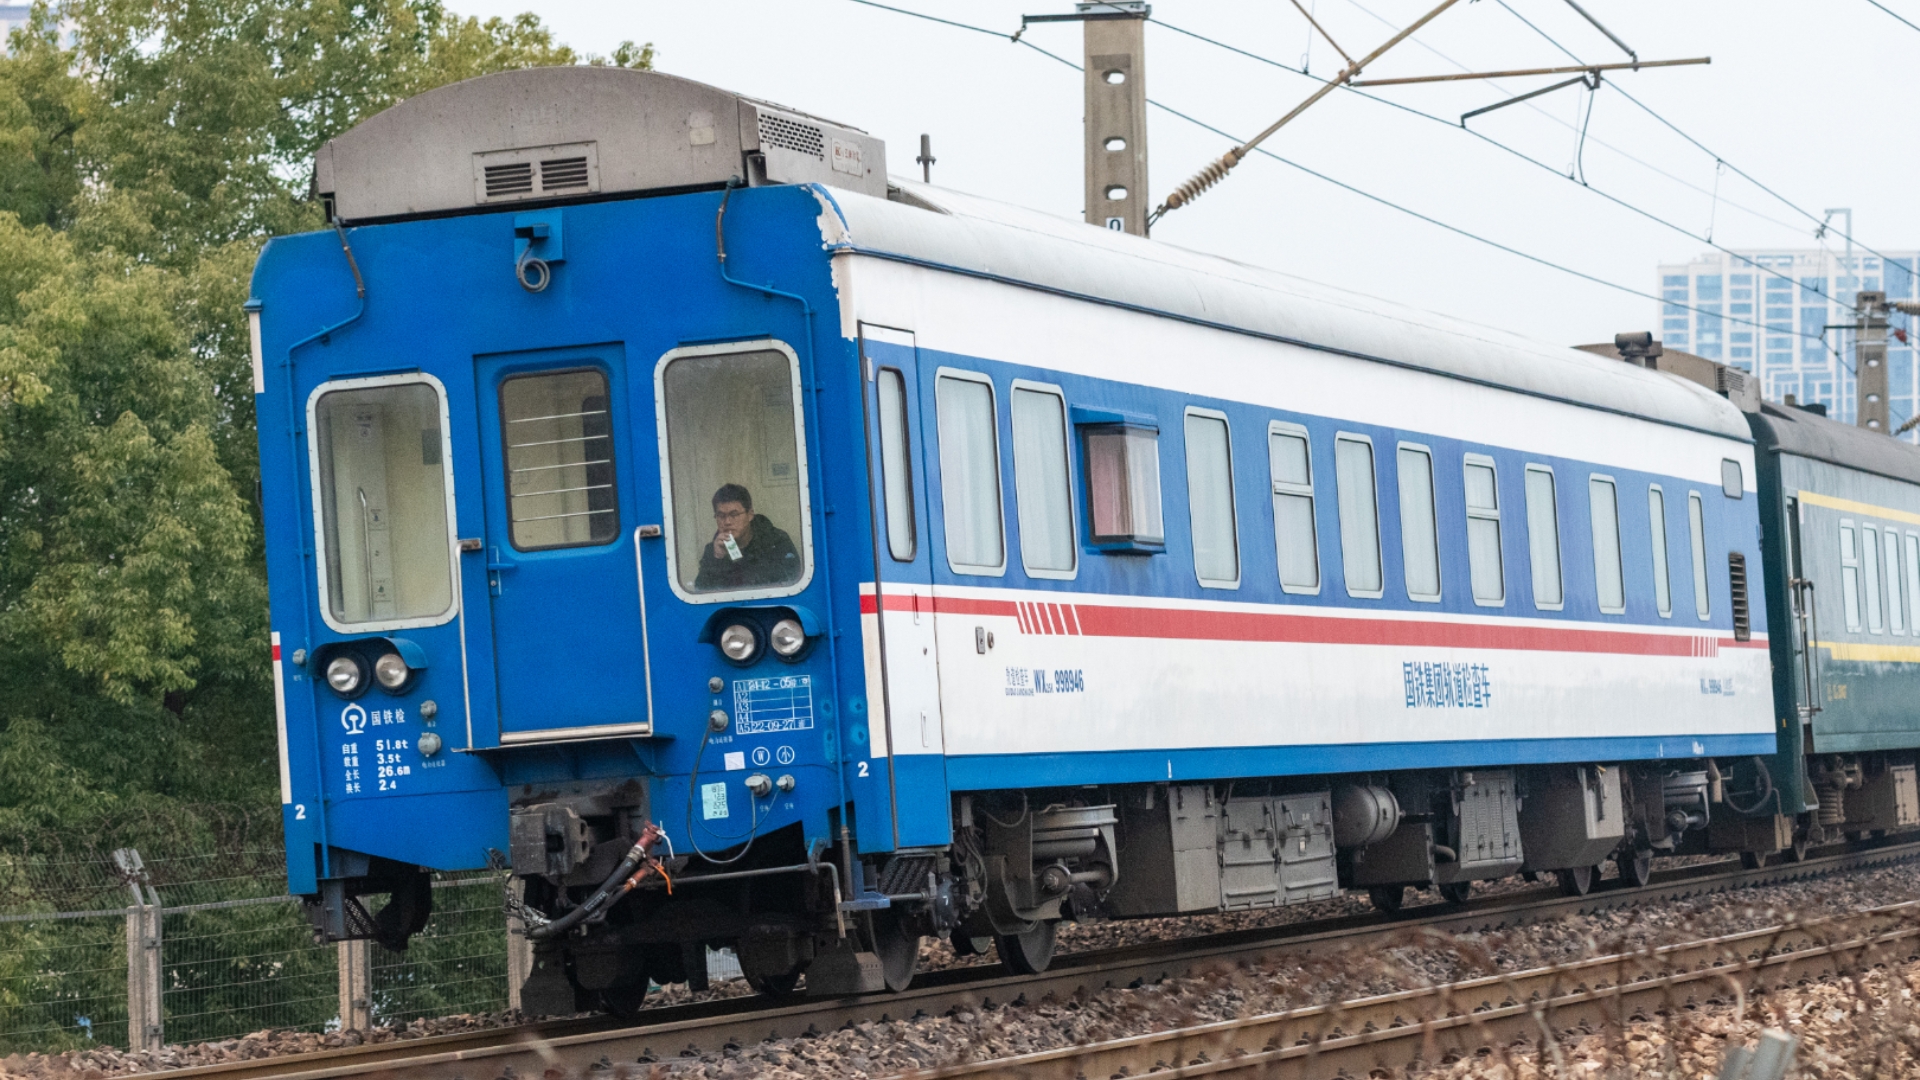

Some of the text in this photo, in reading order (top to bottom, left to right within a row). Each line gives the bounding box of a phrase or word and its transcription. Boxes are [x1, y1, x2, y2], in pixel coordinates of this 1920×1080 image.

[1054, 669, 1084, 693] 998946
[1403, 661, 1491, 708] 国铁集团轨道检查车
[737, 692, 749, 702] A2
[737, 702, 749, 712] A3
[371, 708, 405, 726] 国铁检
[738, 713, 749, 723] A4
[739, 723, 751, 733] A5
[752, 719, 794, 732] 22-09-27
[342, 739, 409, 754] 自重 51.8t
[377, 753, 402, 765] 3.5t
[345, 765, 411, 781] 全长 26.6m
[857, 761, 870, 778] 2
[345, 779, 397, 794] 换长 2.4
[295, 804, 306, 820] 2
